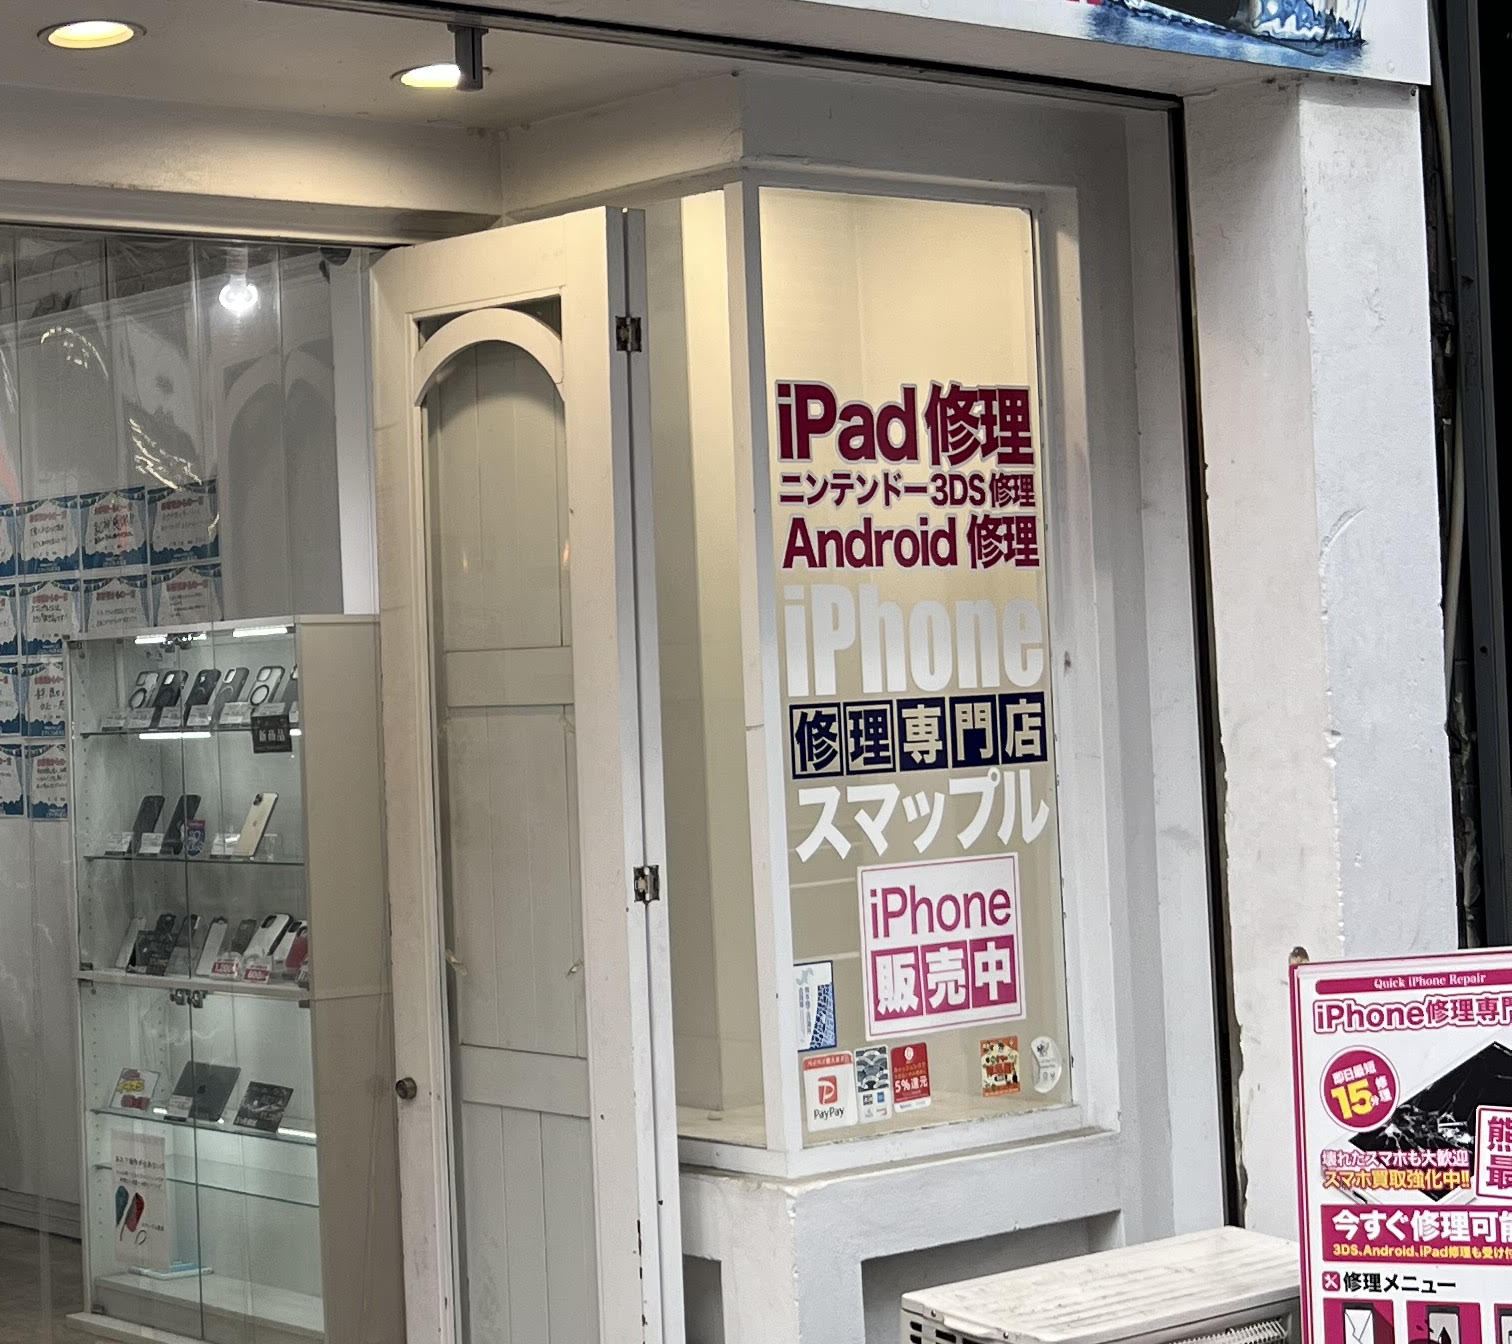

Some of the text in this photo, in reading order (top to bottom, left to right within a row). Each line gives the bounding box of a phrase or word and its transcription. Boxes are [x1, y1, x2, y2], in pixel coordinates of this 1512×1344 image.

[775, 380, 1035, 468] iPad修理
[778, 471, 1036, 508] ニンテンドー3DS修理
[783, 583, 1044, 697] iPhone
[792, 695, 1045, 775] 修理専門店
[796, 766, 1050, 863] スマップル
[870, 885, 1012, 939] iPhone
[874, 940, 1014, 1016] 販売中
[1374, 973, 1487, 989] Quick iPhone Repair
[894, 1077, 928, 1094] 5%還元
[813, 1106, 845, 1121] PayPay
[1321, 1149, 1470, 1167] 壊れたスマホも大歓迎
[1343, 1271, 1457, 1294] 修理メニュー
